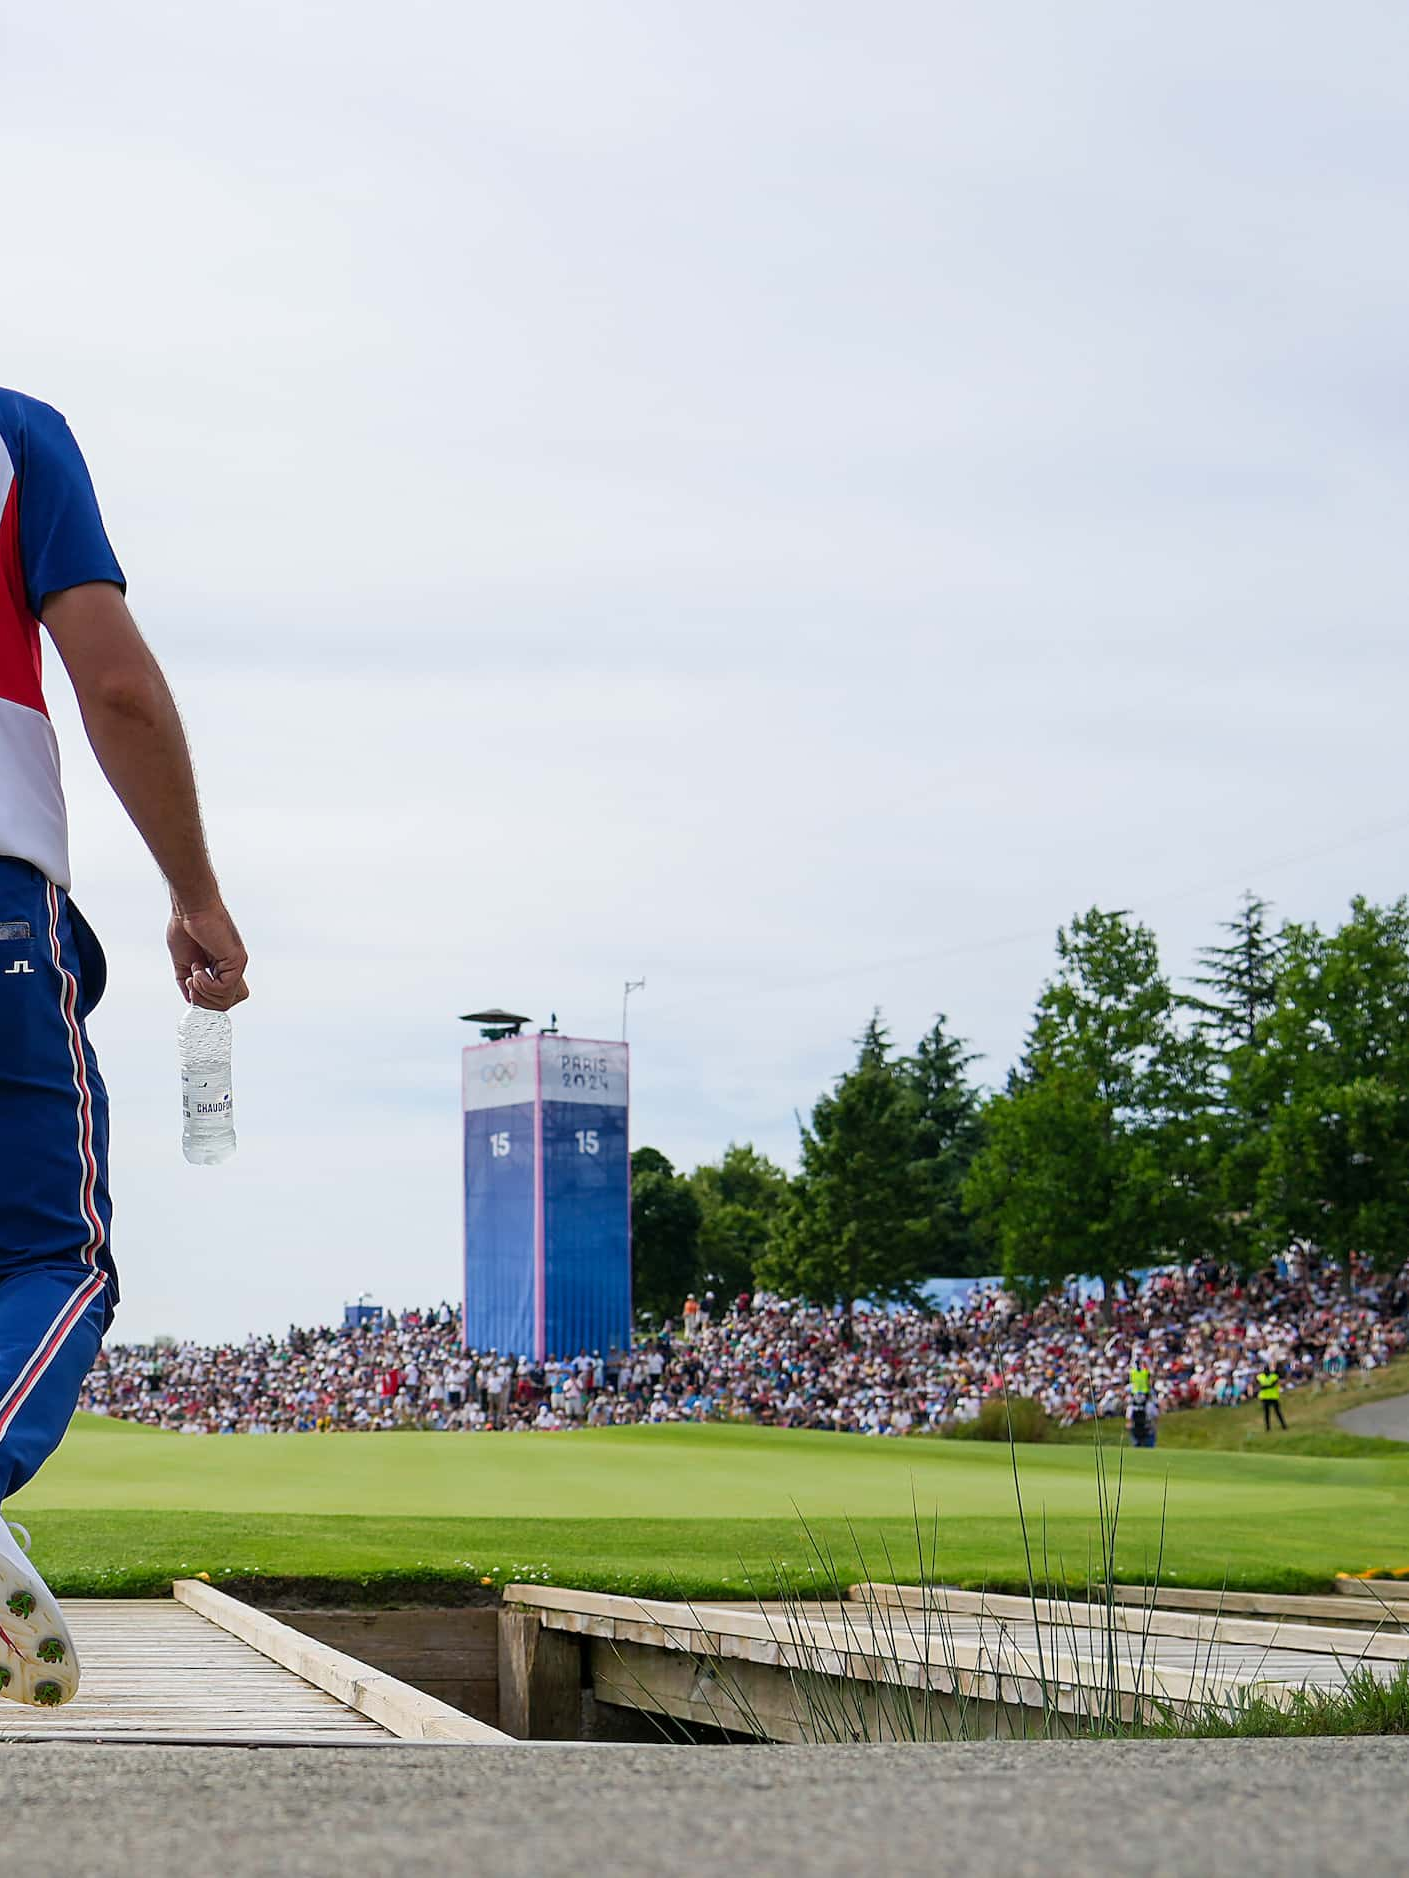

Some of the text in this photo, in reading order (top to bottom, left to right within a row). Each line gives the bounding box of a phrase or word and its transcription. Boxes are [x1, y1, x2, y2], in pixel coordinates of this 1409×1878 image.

[561, 1055, 607, 1072] PARIS
[562, 1072, 609, 1090] 2024
[489, 1131, 511, 1157] 15
[575, 1130, 599, 1155] 15
